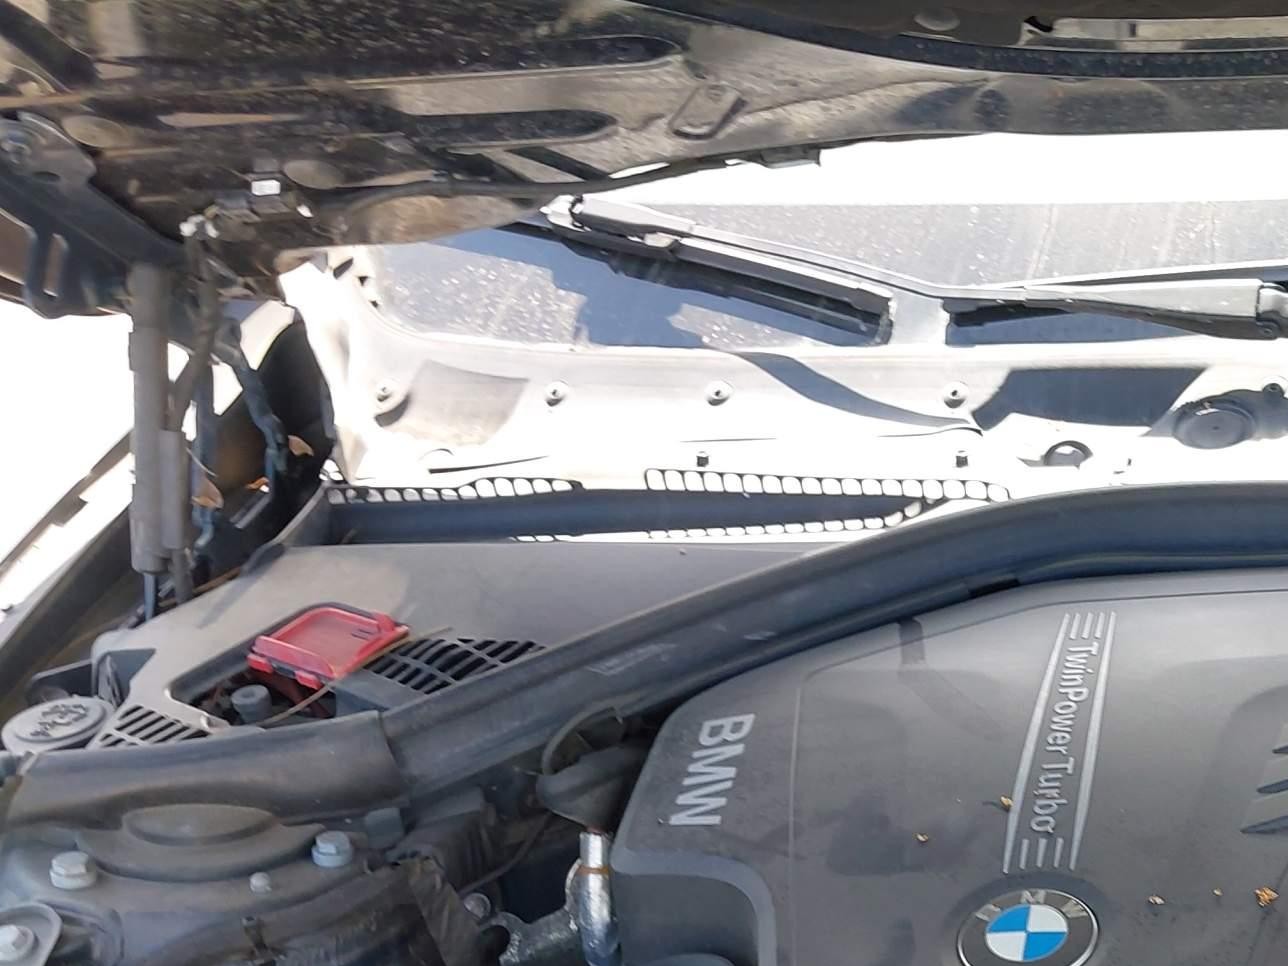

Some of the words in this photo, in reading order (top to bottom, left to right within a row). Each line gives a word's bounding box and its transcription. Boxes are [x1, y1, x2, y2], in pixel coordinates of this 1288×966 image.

[1045, 641, 1099, 755] TwinPower
[668, 713, 755, 826] BMW
[1030, 757, 1074, 833] Turbo
